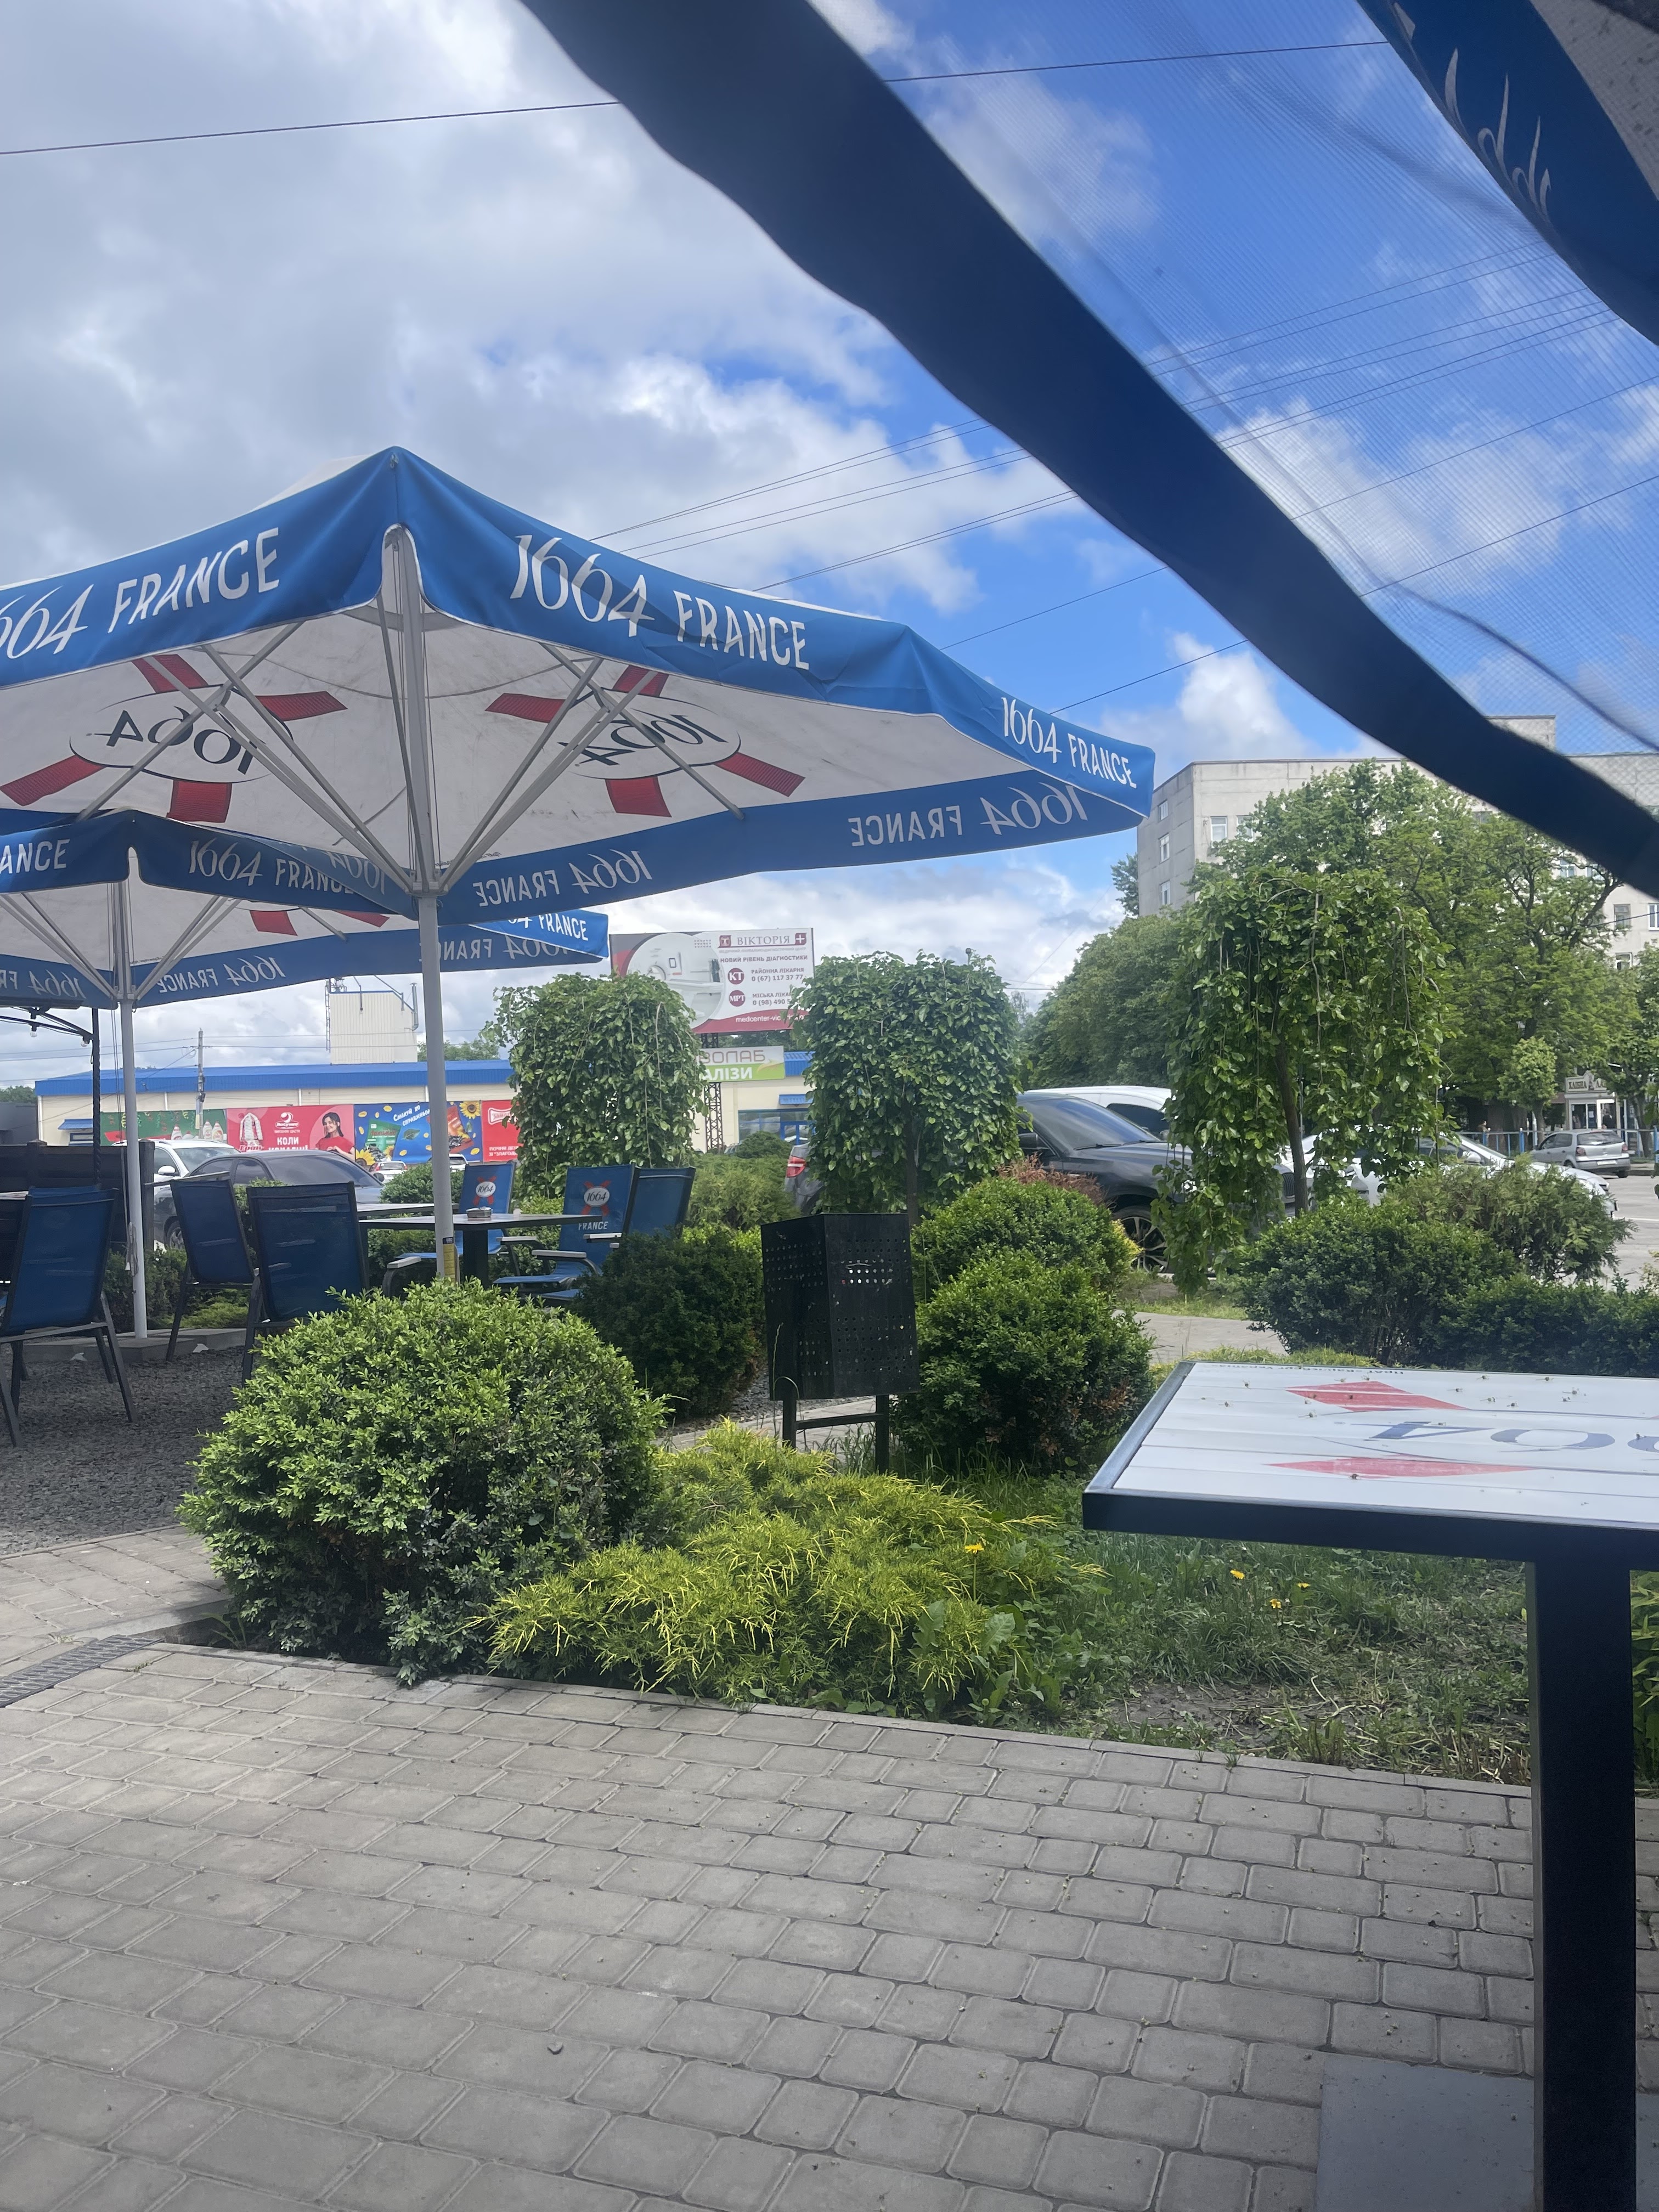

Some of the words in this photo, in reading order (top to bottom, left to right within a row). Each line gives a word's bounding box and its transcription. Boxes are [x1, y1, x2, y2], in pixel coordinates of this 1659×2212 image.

[0, 584, 94, 659] 664
[108, 527, 279, 633] FRANCE
[510, 534, 655, 637] 1664
[673, 590, 810, 670] FRANCE
[1001, 697, 1062, 764] 1664
[1067, 732, 1137, 789] FRANCE
[0, 839, 70, 874] ANCE
[189, 838, 263, 886] 1664
[538, 913, 589, 941] FRANCE
[737, 935, 790, 945] ВІКТОРІЯ
[729, 972, 744, 981] КТ
[702, 1066, 753, 1081] АЛІЗИ
[277, 1137, 299, 1145] КОЛИ
[586, 1191, 607, 1202] 1664
[578, 1221, 609, 1231] FRANCE
